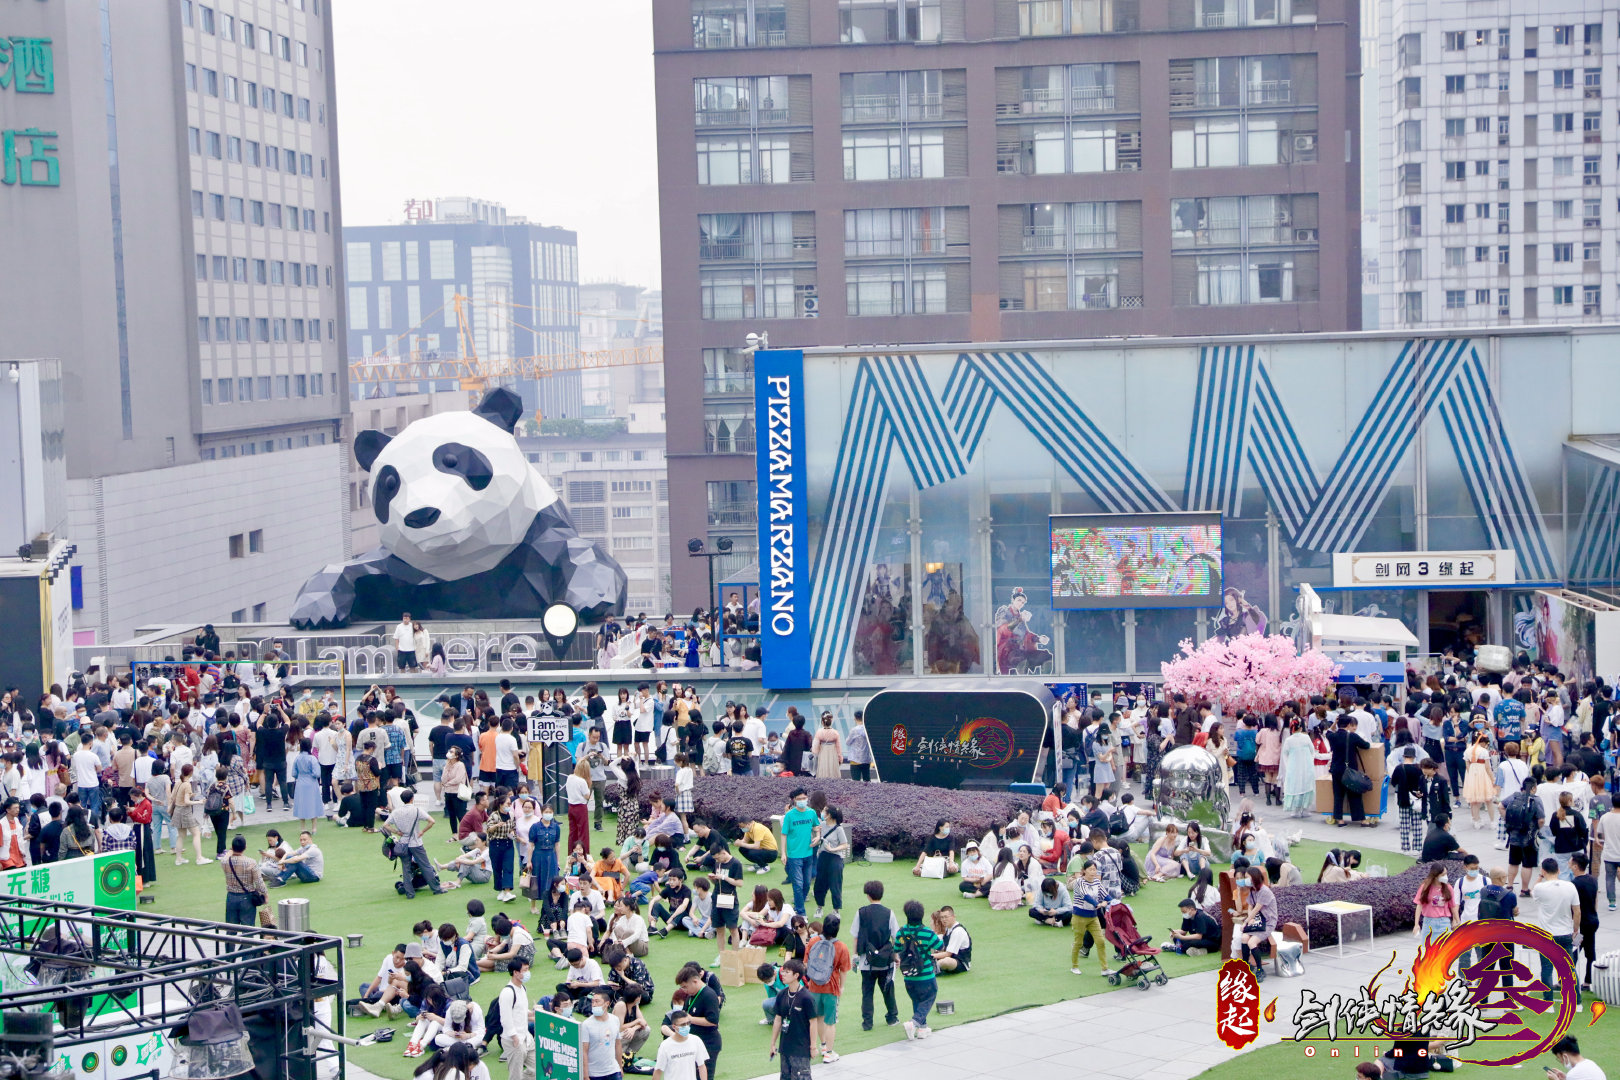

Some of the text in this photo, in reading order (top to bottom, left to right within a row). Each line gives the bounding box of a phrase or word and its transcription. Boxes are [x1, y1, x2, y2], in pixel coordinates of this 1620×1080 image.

[0, 36, 60, 187] 酒店
[1375, 561, 1474, 577] 剑网3缘起
[318, 645, 394, 675] am
[430, 635, 537, 673] ere
[532, 719, 536, 729] I
[537, 721, 556, 730] am
[532, 730, 564, 741] Here
[7, 867, 50, 897] 无糖
[538, 1034, 561, 1053] YOUNG
